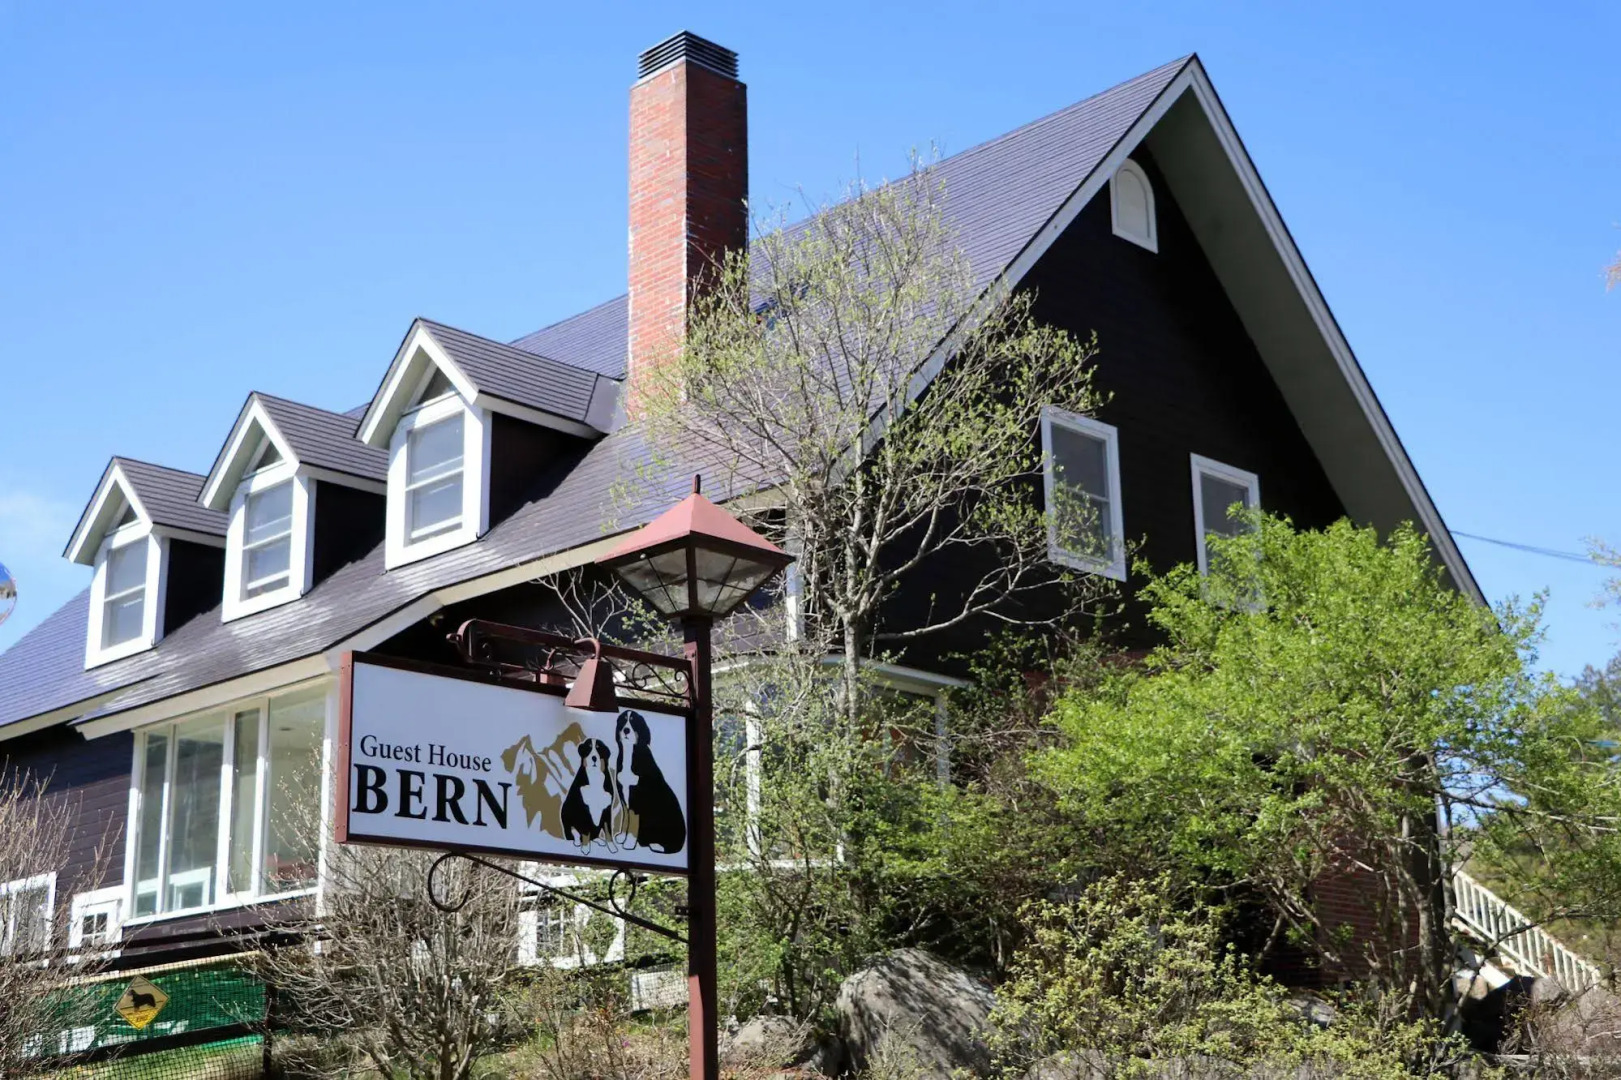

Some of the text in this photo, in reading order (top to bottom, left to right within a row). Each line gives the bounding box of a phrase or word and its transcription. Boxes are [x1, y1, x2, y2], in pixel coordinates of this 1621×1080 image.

[360, 734, 492, 772] Guest House
[351, 763, 512, 829] BERN
